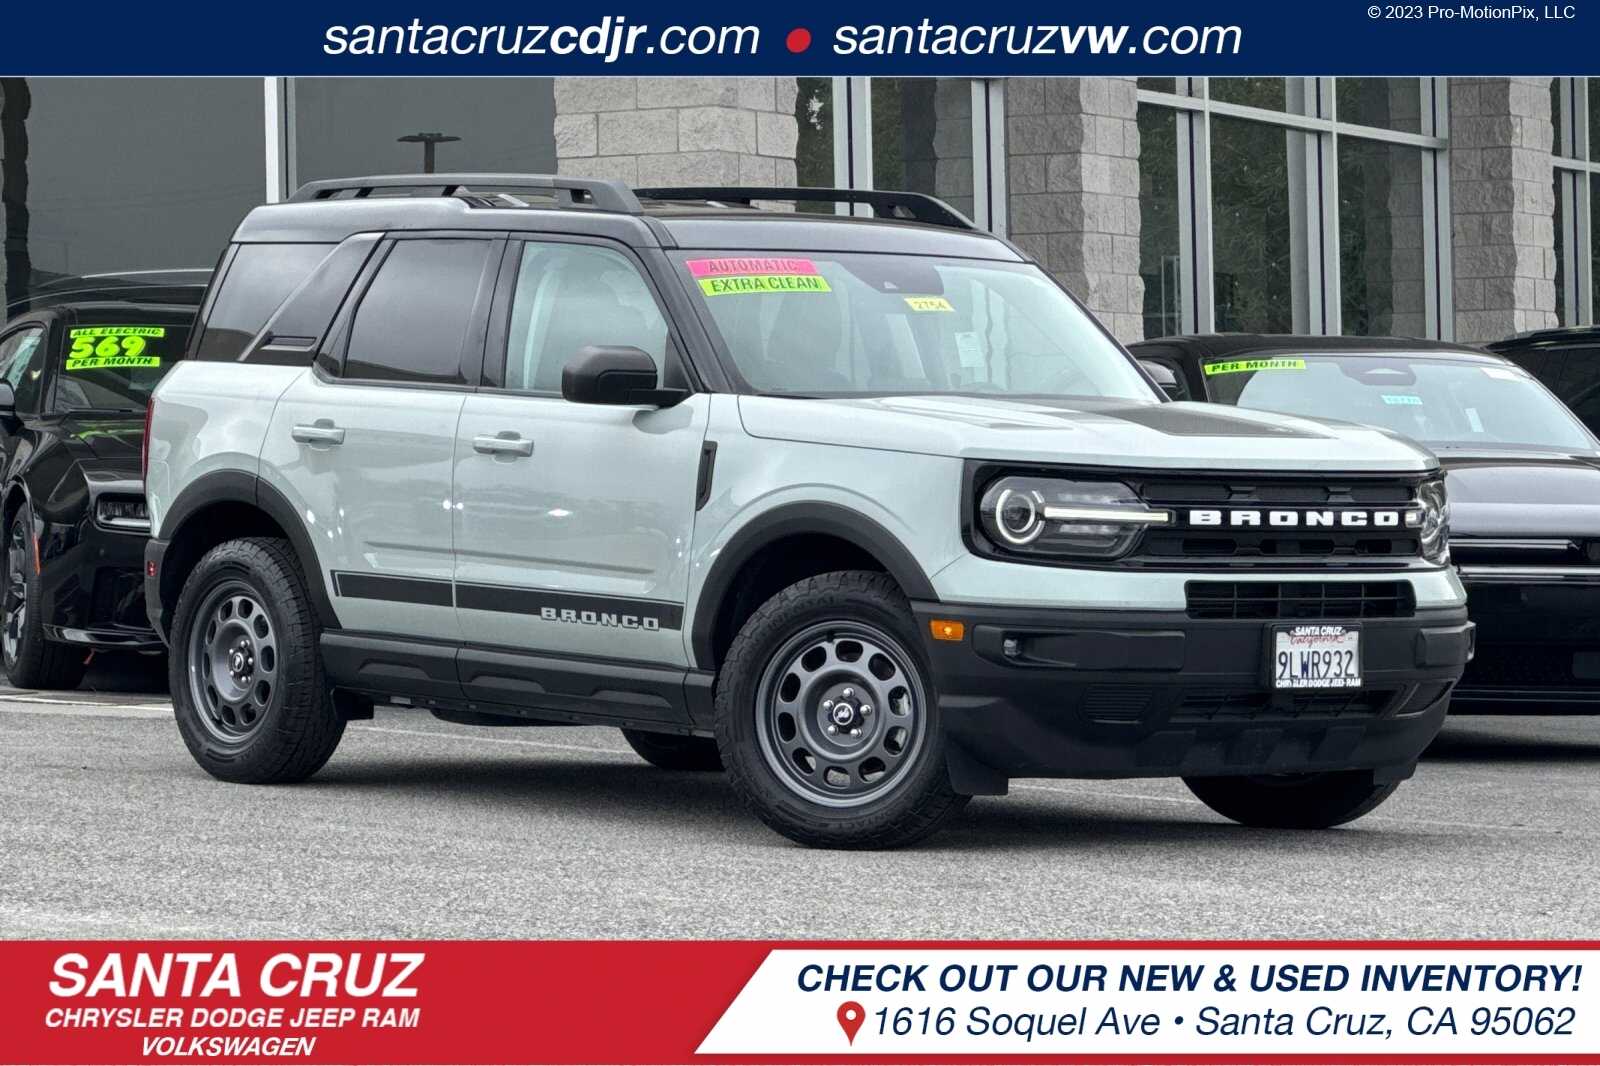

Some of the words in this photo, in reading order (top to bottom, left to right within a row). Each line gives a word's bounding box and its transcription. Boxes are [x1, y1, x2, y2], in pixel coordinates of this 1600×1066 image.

[709, 259, 799, 273] AUTOMATIC
[711, 278, 766, 293] EXTRA
[768, 276, 818, 290] CLEAN
[73, 329, 96, 337] ALL
[100, 327, 161, 336] ELECTRIC
[69, 336, 146, 359] 569
[72, 359, 99, 367] PER
[104, 357, 152, 366] MONTH
[1211, 363, 1241, 373] PER
[1245, 360, 1298, 370] MONTH
[1189, 509, 1400, 527] BRONCO
[540, 605, 660, 631] BRONCO
[1294, 626, 1320, 636] SANTA
[1320, 626, 1343, 636] CRUZ
[1277, 649, 1355, 680] 9LWR932
